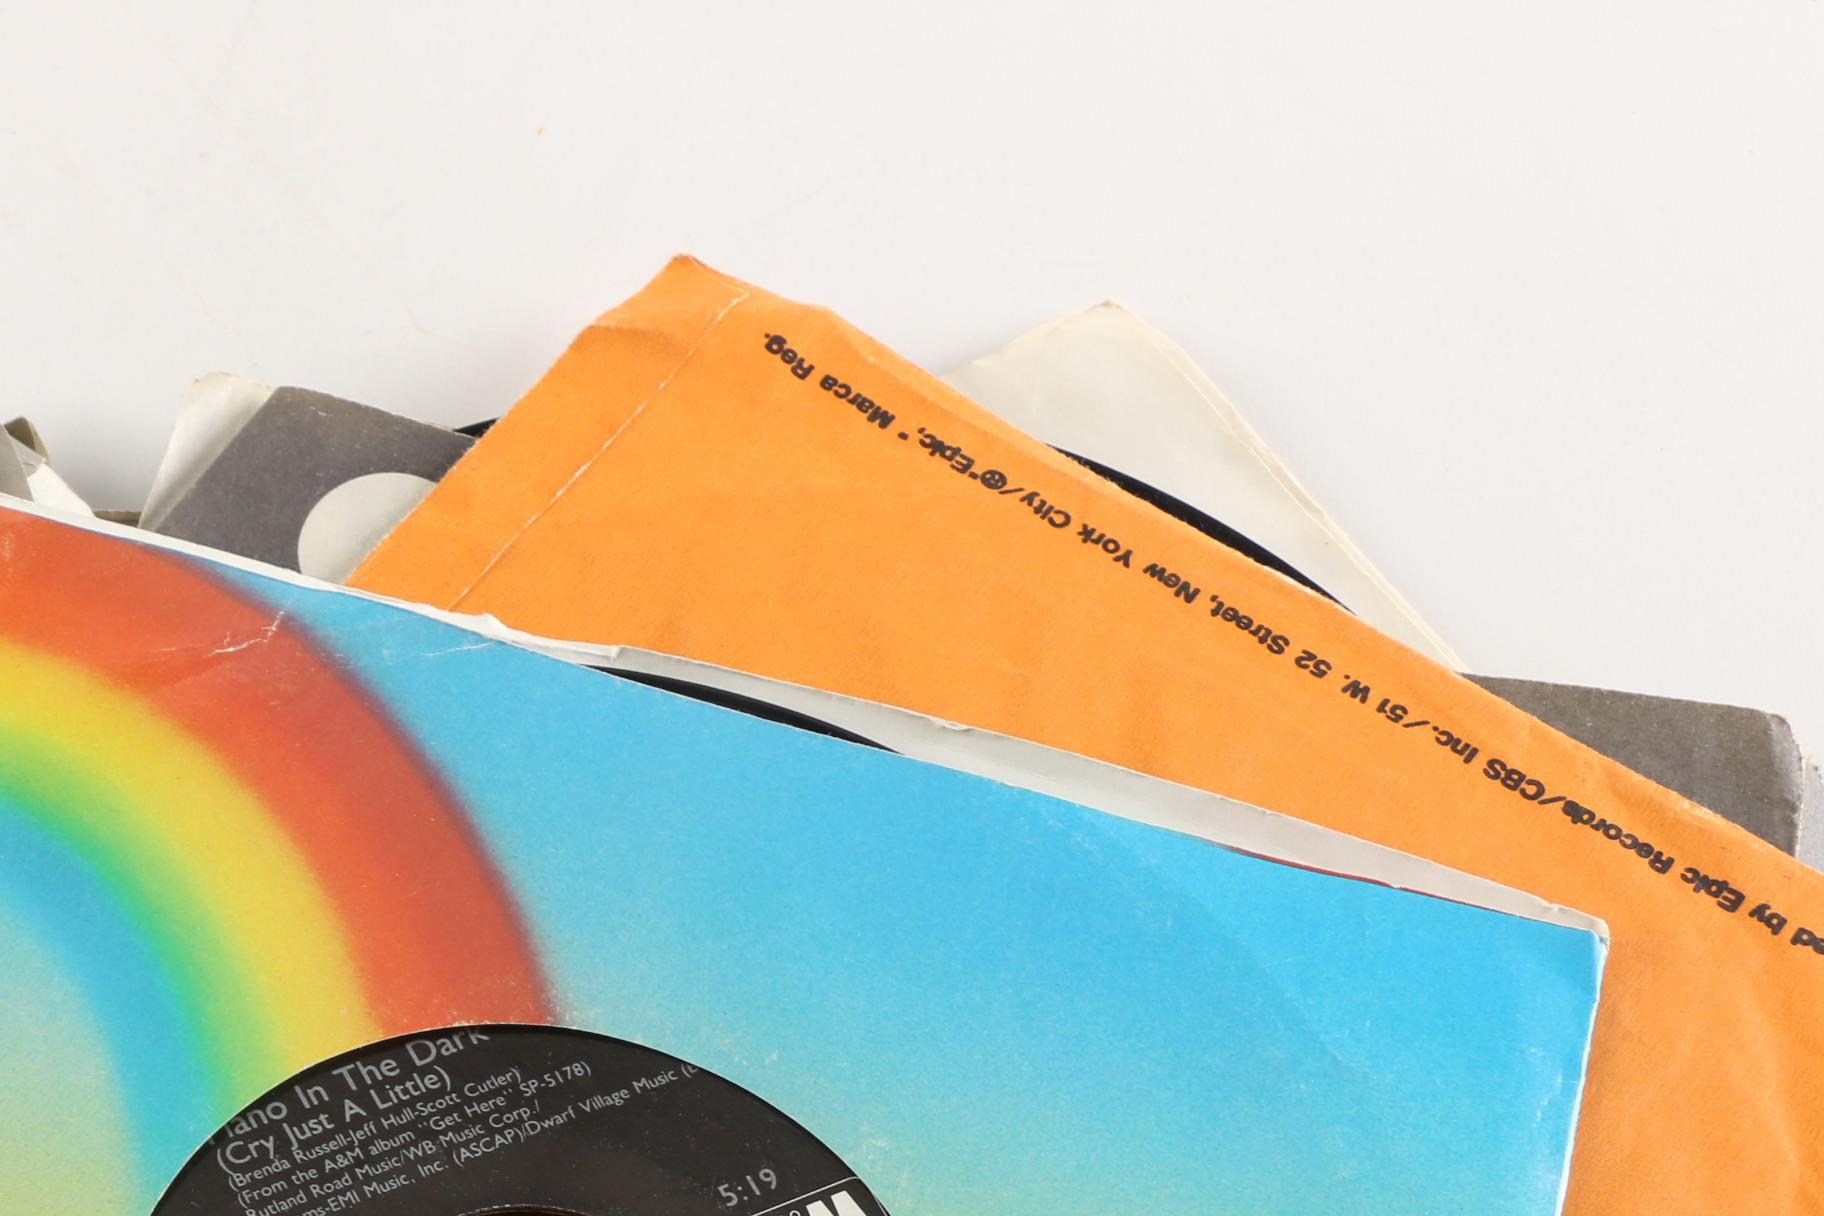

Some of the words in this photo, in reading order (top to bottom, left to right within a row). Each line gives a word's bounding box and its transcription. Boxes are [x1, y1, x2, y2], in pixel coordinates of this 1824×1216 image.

[764, 332, 815, 380] Reg.
[820, 374, 896, 430] Marca
[1078, 523, 1133, 568] York
[1143, 562, 1201, 604] New
[1209, 593, 1290, 655] Street,
[1294, 649, 1333, 678] 52
[1342, 674, 1371, 703] W.
[1482, 758, 1675, 874] Records/CBS
[1680, 865, 1746, 913] Epic
[1748, 903, 1788, 936] by
[294, 1084, 328, 1109] In
[333, 1059, 400, 1090] The
[217, 1136, 275, 1175] (Cry
[283, 1113, 334, 1150] Just
[344, 1099, 366, 1122] A
[370, 1065, 451, 1110] Little)
[228, 1158, 291, 1192] (Brenda
[293, 1122, 377, 1164] Russell-Jeff
[381, 1093, 461, 1130] Hull-Scott
[464, 1066, 522, 1097] Cutler)
[238, 1179, 288, 1209] (From
[292, 1168, 319, 1185] the
[324, 1149, 364, 1174] A&M
[368, 1130, 415, 1155] album
[519, 1061, 591, 1097] SP-5178)
[362, 1171, 416, 1199] Music,
[417, 1158, 449, 1178] Inc.
[452, 1106, 577, 1168] (ASCAP)/Dwarf
[578, 1088, 630, 1114] Village
[632, 1070, 677, 1094] Music
[310, 1174, 352, 1199] Road
[356, 1140, 437, 1181] Music/WB
[439, 1125, 484, 1148] Music
[717, 1167, 777, 1207] 5:19
